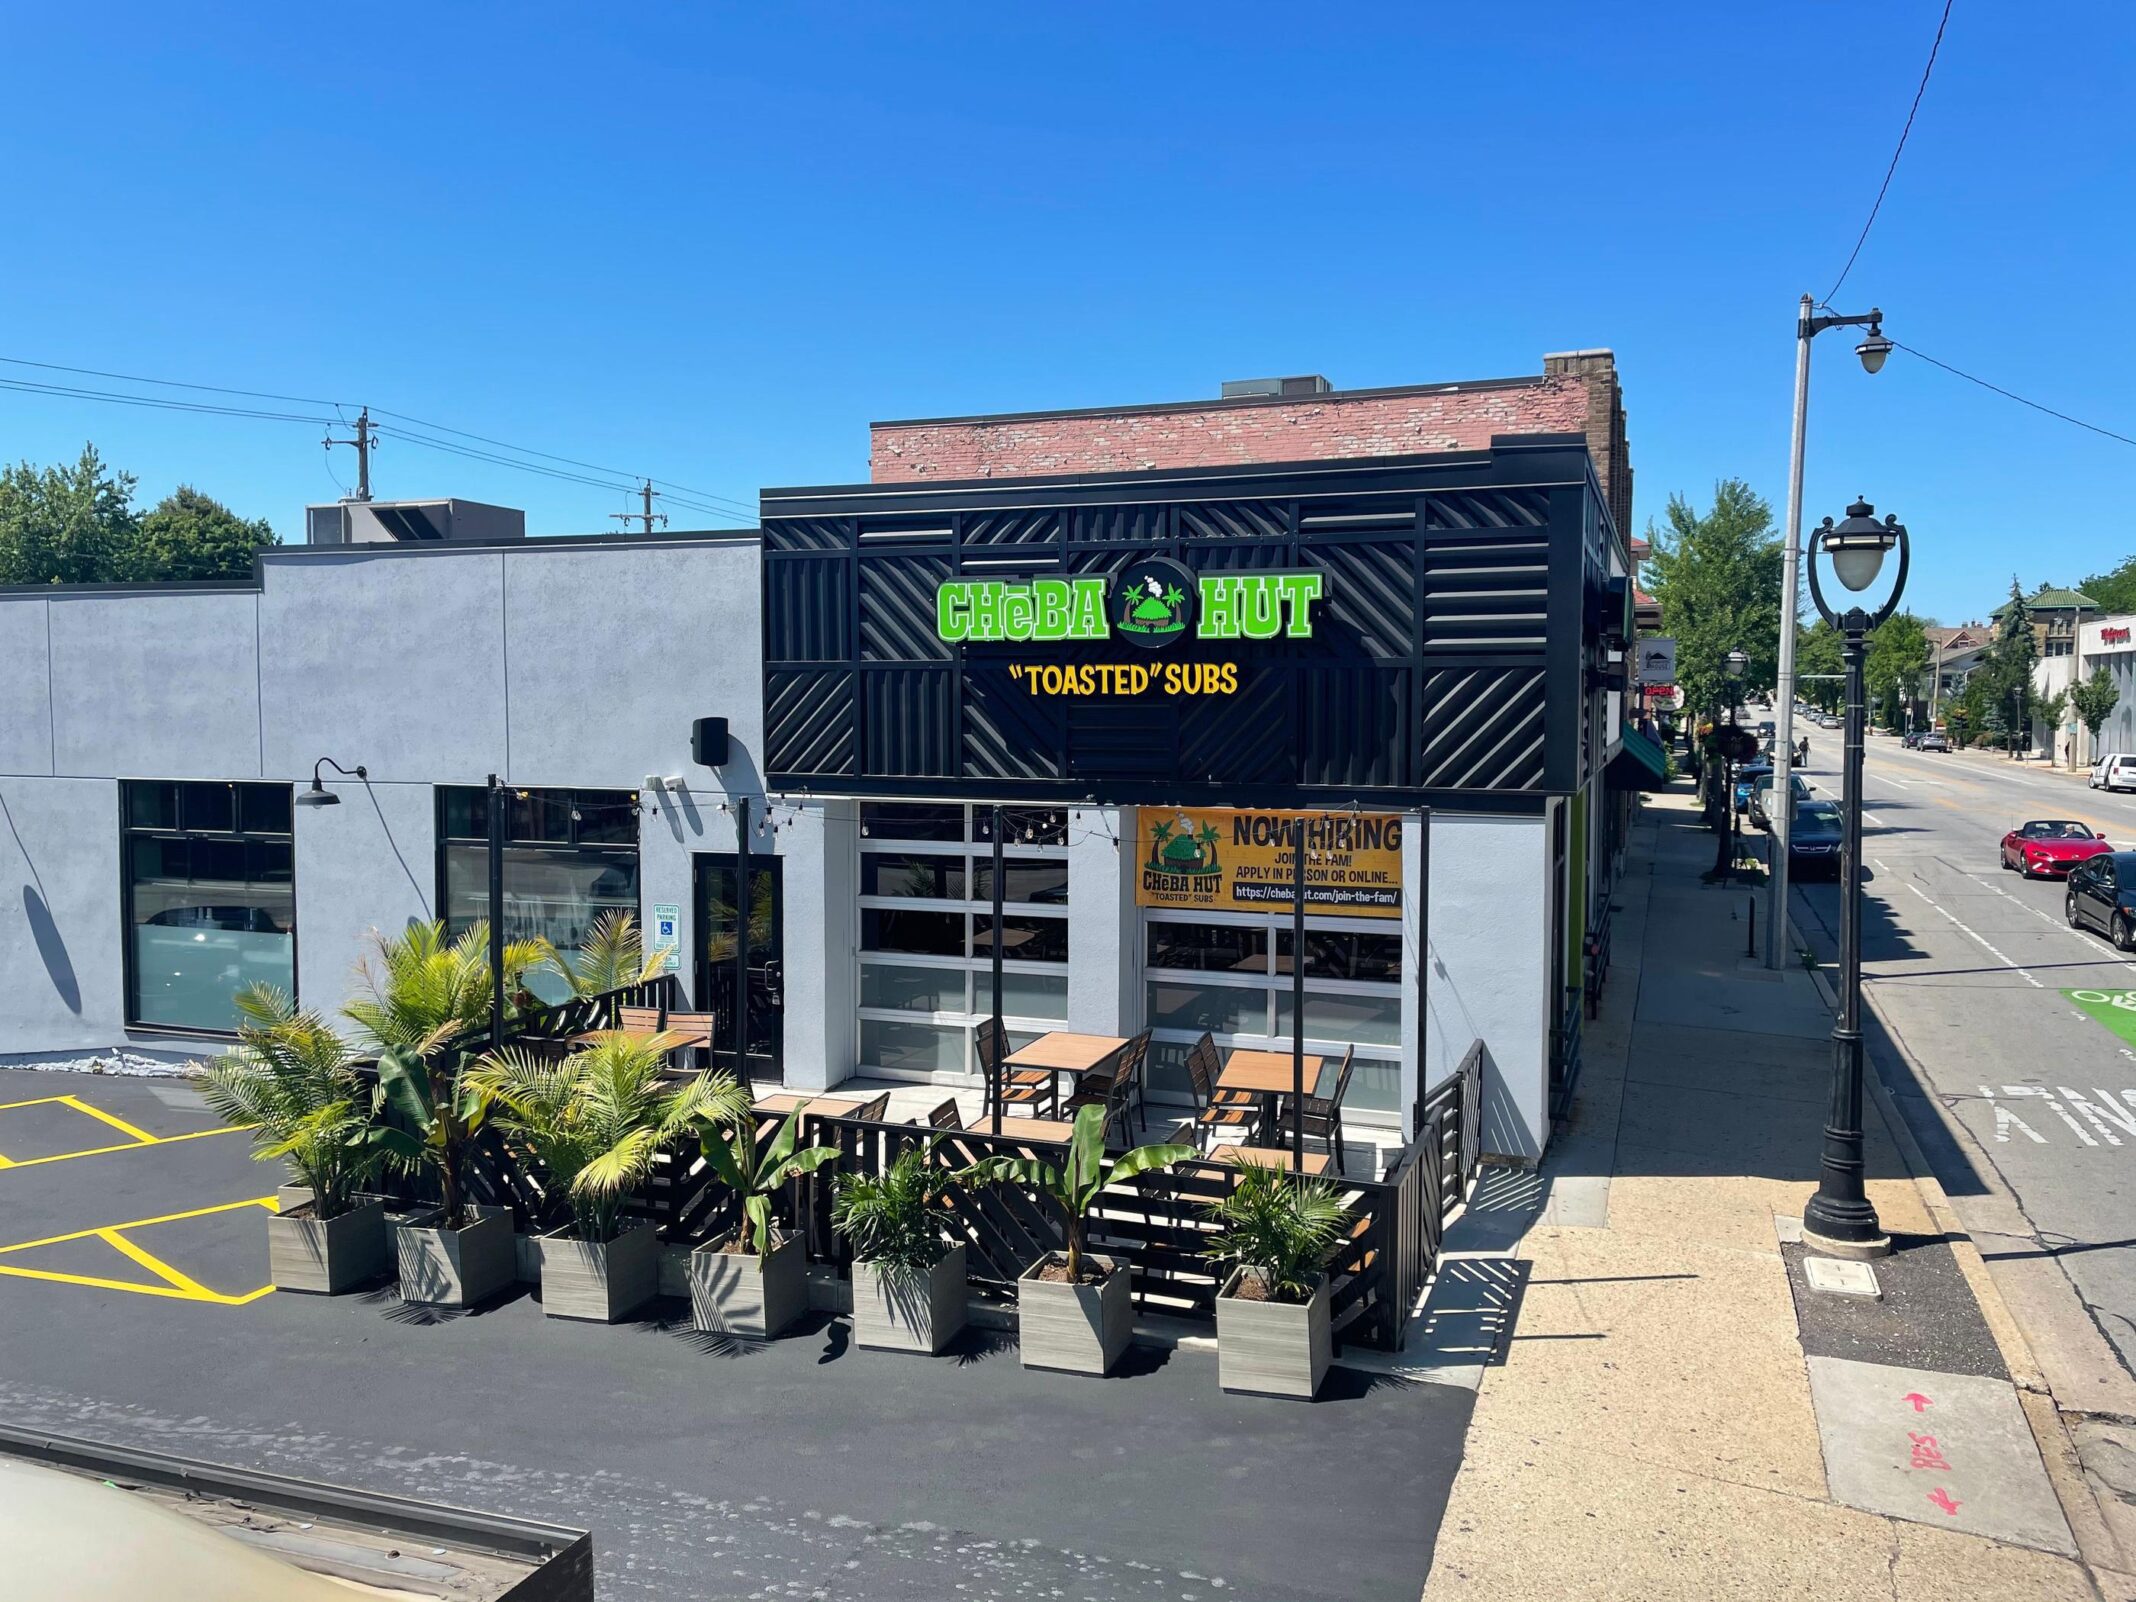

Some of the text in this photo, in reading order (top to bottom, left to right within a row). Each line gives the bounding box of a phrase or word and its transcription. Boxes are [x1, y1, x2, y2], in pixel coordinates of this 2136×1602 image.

[1197, 573, 1322, 640] HUT
[1163, 662, 1238, 695] SUBS
[1645, 687, 1673, 696] OPEN
[1233, 815, 1402, 851] NOW HIRING
[1325, 853, 1352, 867] FAM!
[1193, 874, 1222, 893] HUT
[1236, 865, 1398, 885] APPLY IN PSON OR ONLINE...
[1194, 894, 1214, 903] SUBS
[1236, 885, 1398, 905] https://chebaut.com/join-the-fam/
